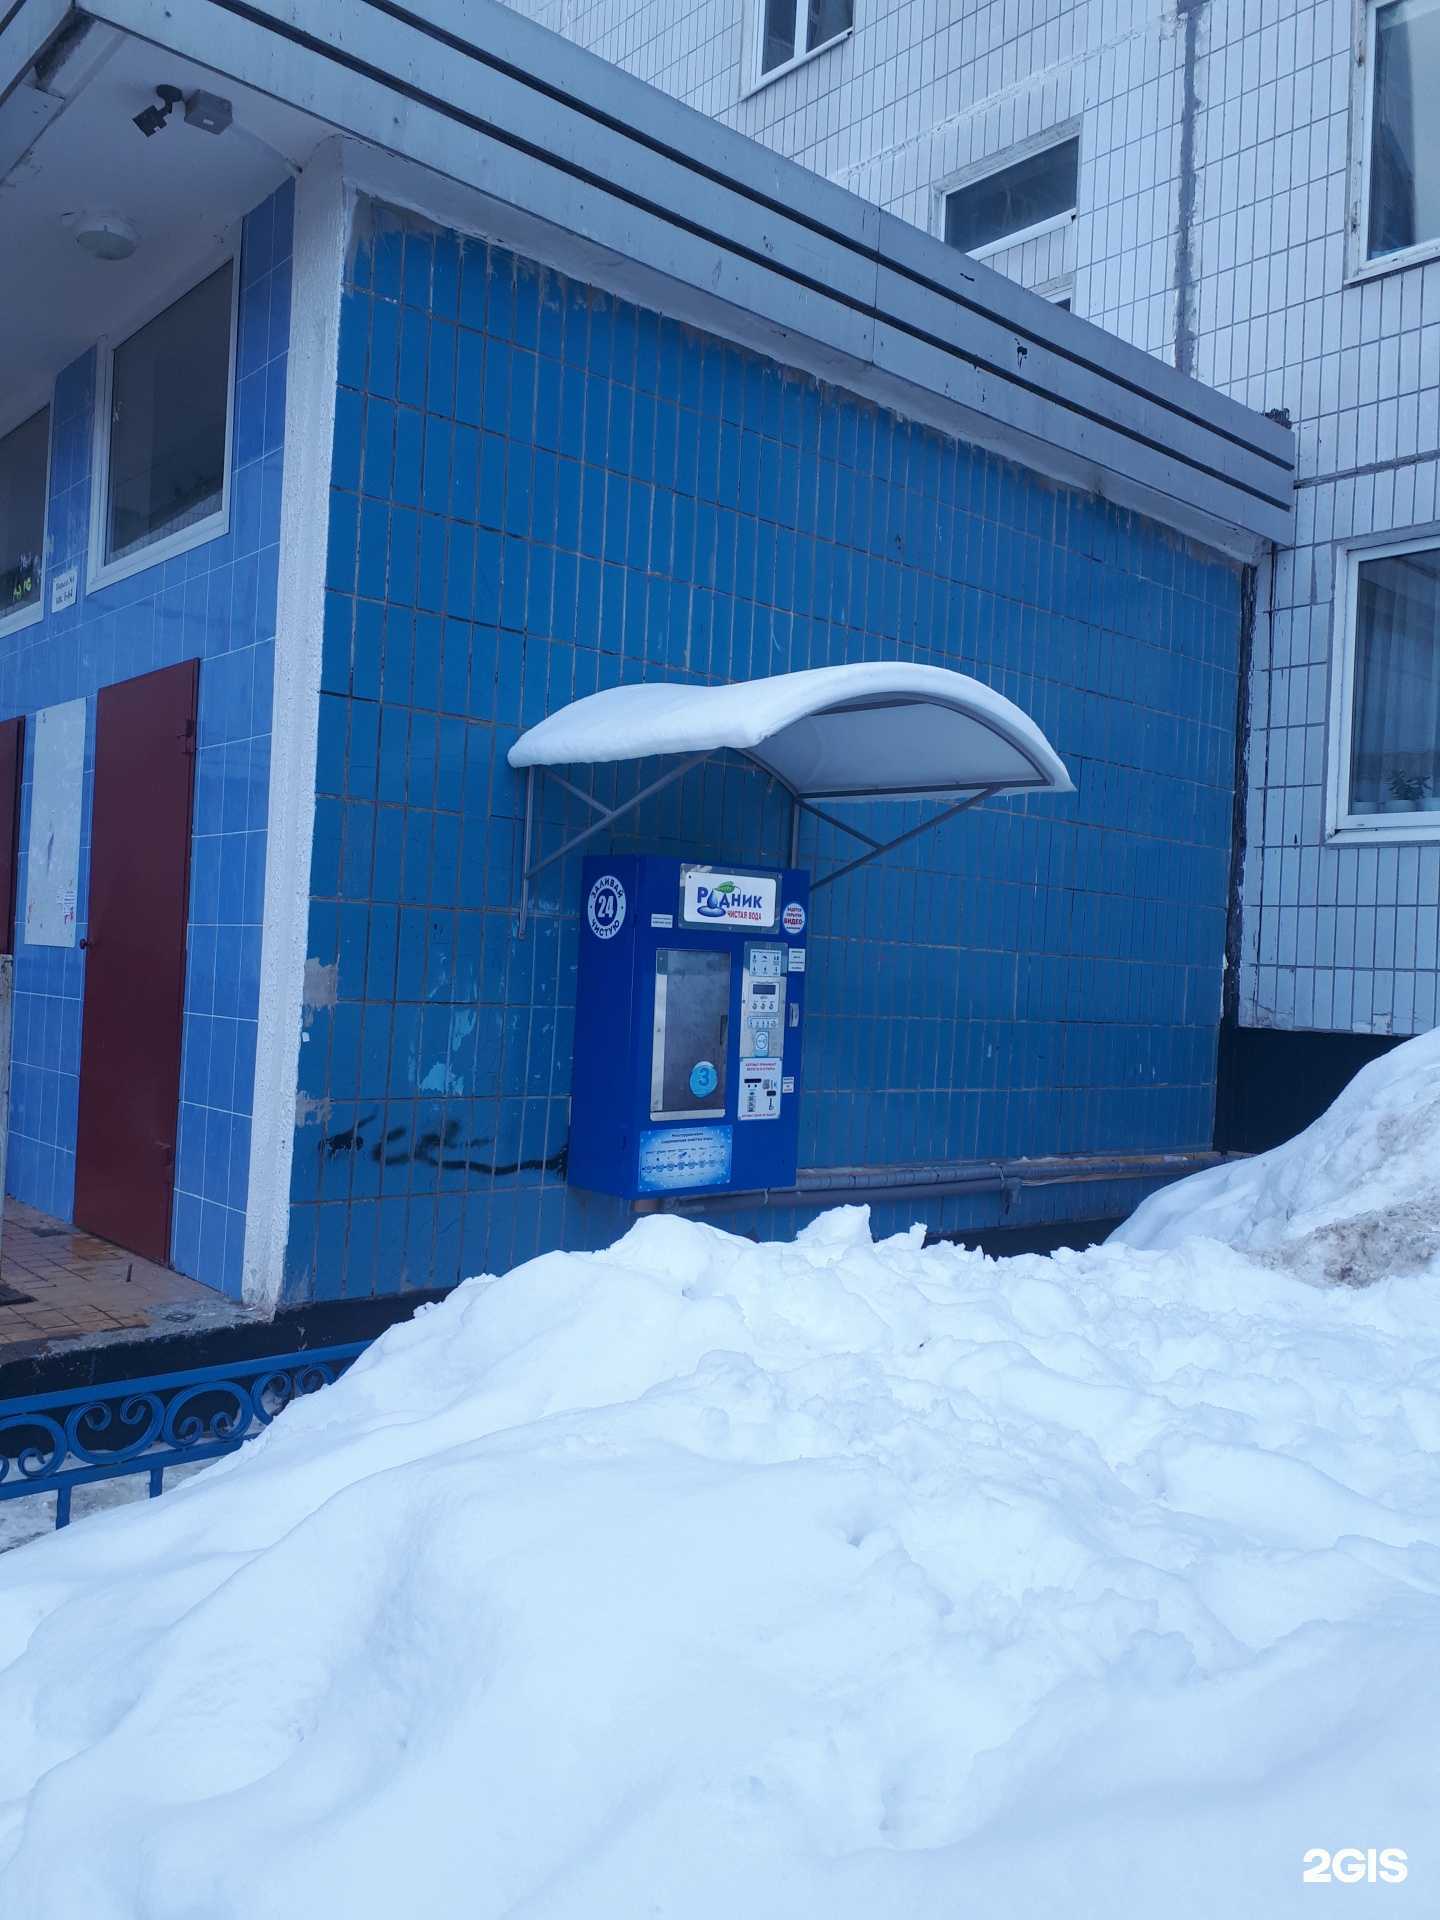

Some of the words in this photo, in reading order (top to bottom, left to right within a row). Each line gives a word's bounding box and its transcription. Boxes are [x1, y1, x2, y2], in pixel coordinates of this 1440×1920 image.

[591, 877, 624, 899] ЗАЛИВАЙ
[597, 895, 614, 918] 24
[727, 910, 747, 920] ЧИСТАЯ
[748, 911, 762, 921] ВОДА
[591, 918, 620, 937] ЧИСТУЮ
[698, 1067, 710, 1087] 3
